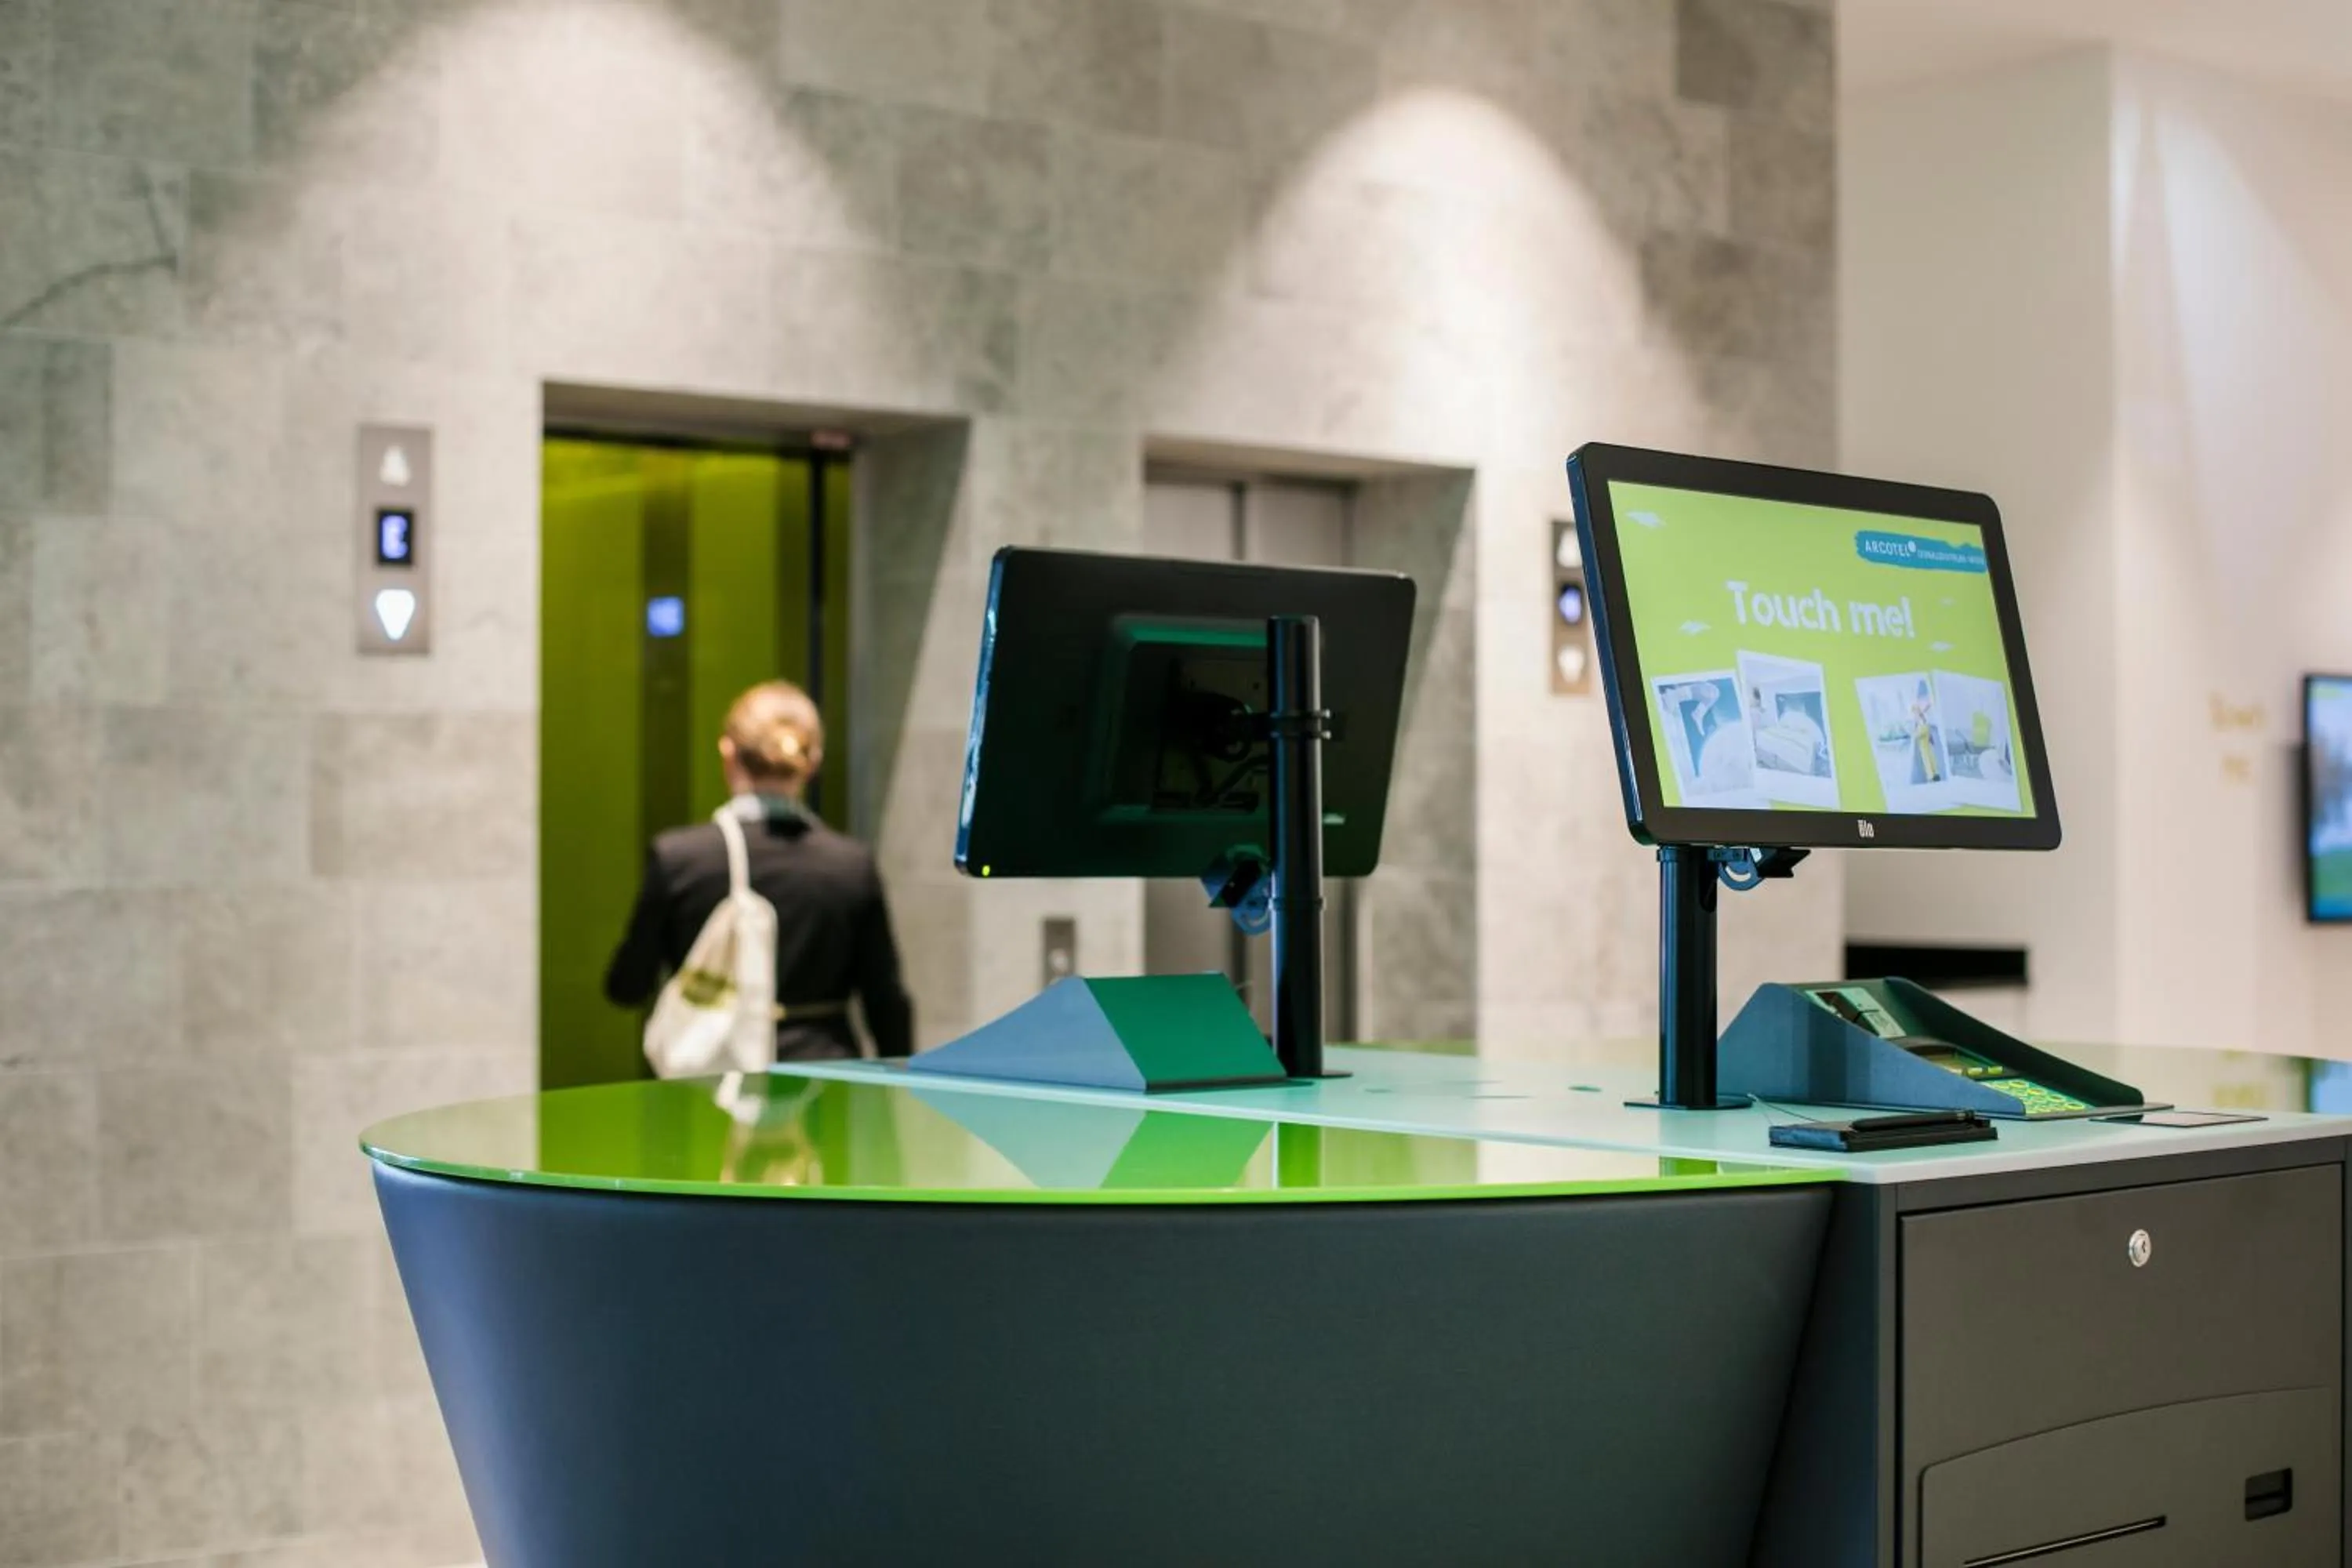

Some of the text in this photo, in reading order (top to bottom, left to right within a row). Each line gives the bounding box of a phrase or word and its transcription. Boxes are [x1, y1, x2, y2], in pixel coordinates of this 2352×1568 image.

[1864, 539, 1911, 557] ARCOTEL
[1725, 579, 1915, 639] Touch me!
